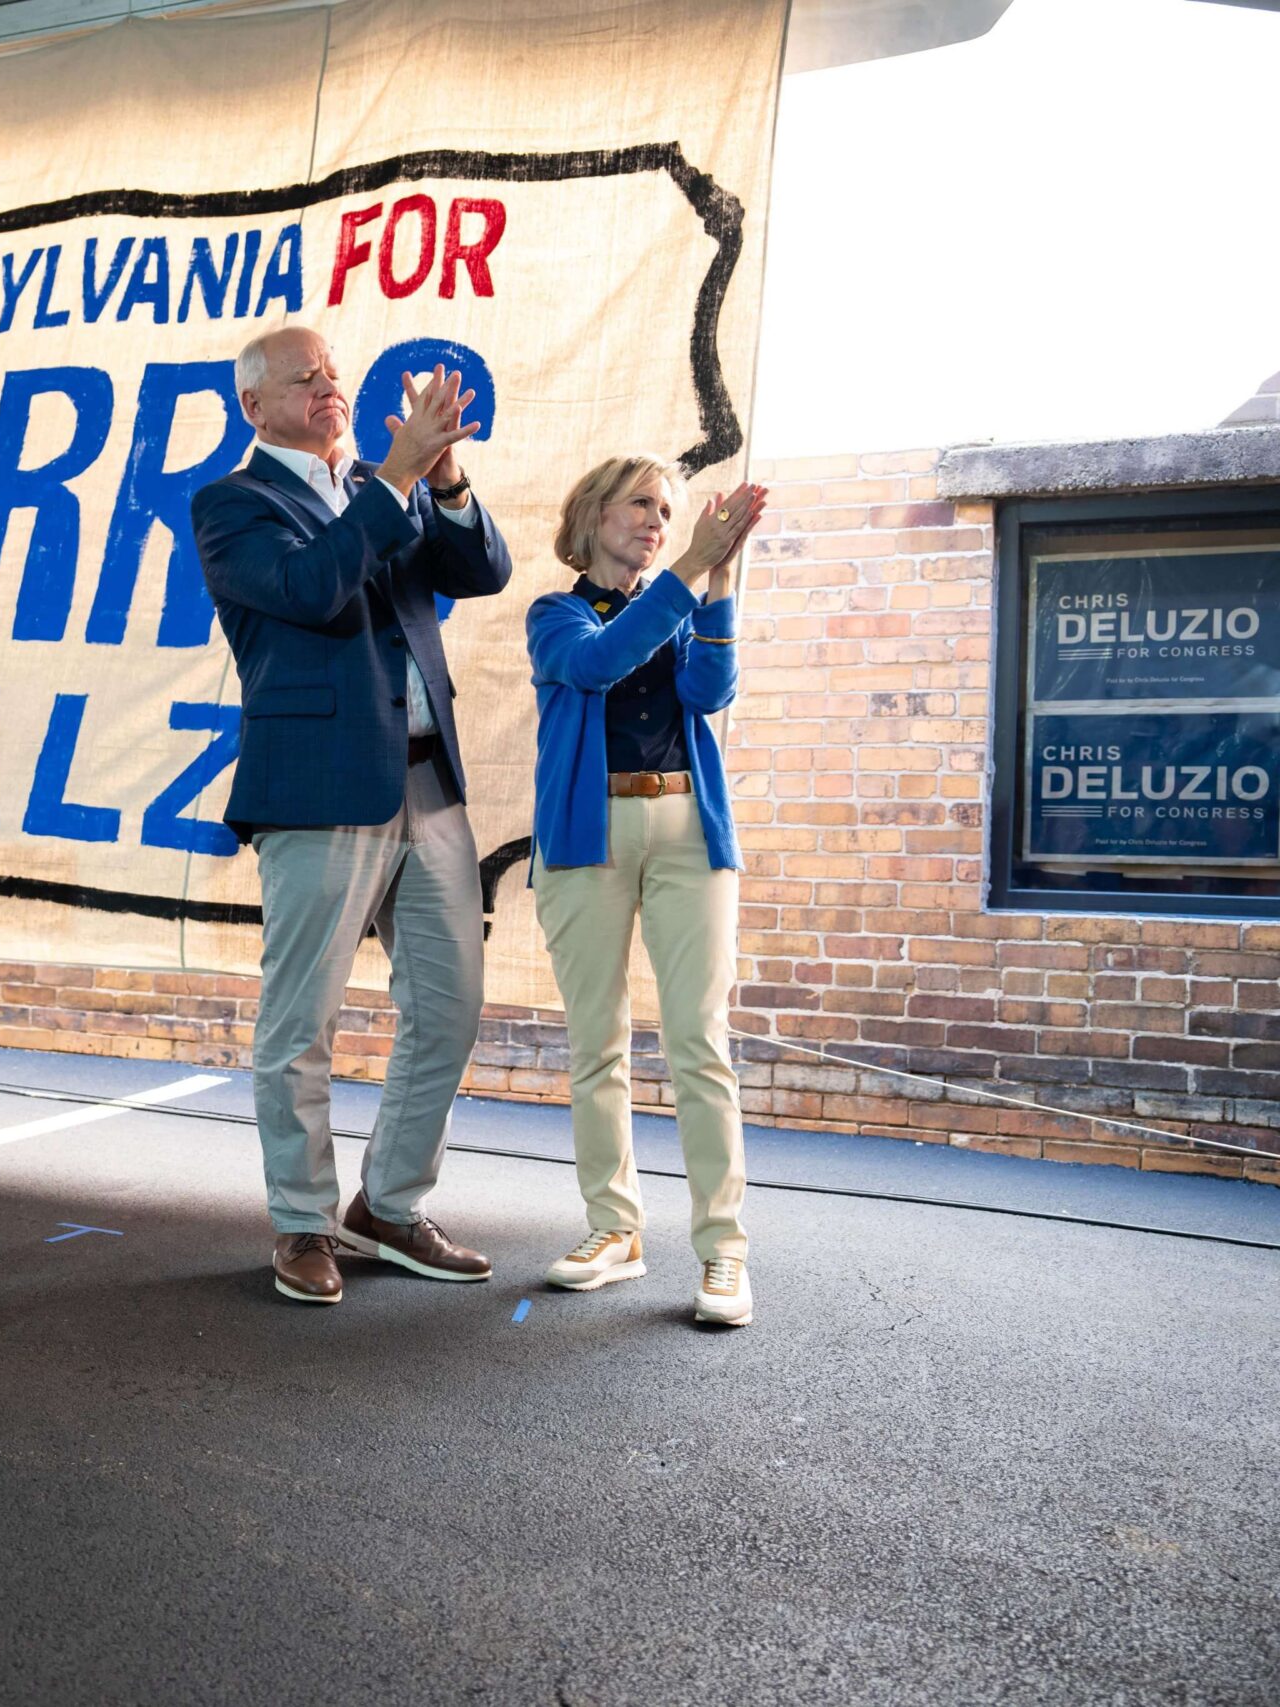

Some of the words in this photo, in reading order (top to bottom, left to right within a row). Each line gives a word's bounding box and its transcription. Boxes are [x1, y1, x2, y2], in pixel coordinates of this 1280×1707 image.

[327, 194, 506, 307] FOR
[1059, 593, 1129, 609] CHRIS
[1057, 607, 1260, 644] DELUZIO
[1117, 647, 1150, 659] FOR
[1159, 645, 1255, 657] CONGRESS
[1042, 746, 1122, 761] CHRIS
[1041, 766, 1269, 800] DELUZIO
[1108, 806, 1145, 818] FOR
[1155, 807, 1265, 819] CONGRESS
